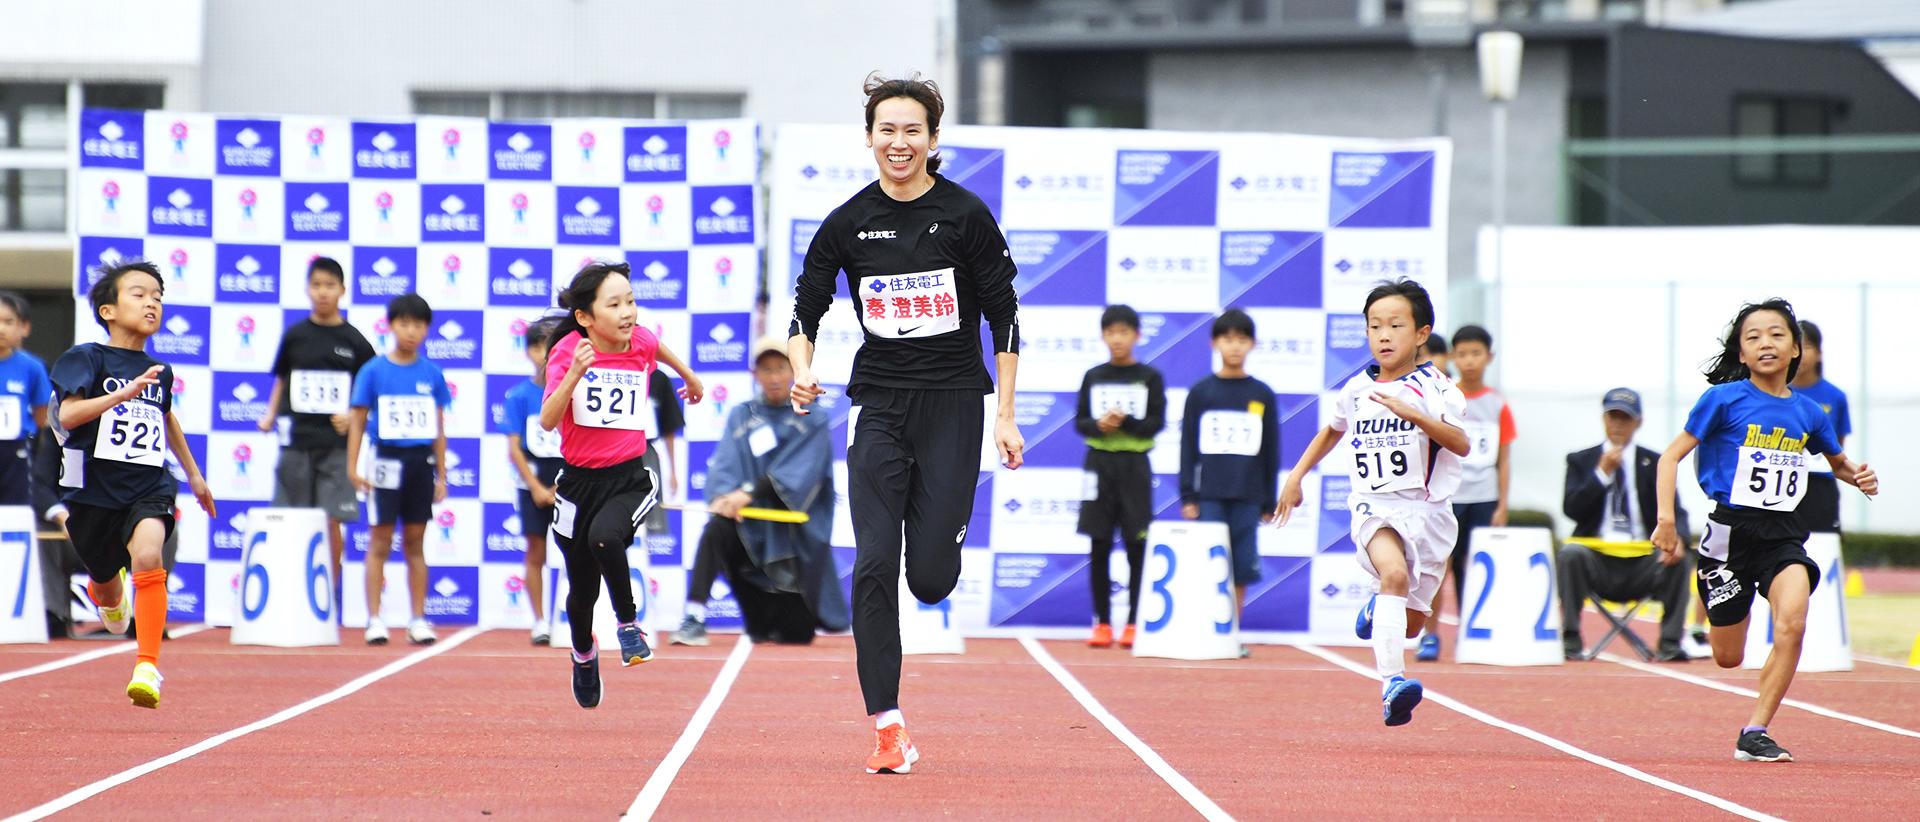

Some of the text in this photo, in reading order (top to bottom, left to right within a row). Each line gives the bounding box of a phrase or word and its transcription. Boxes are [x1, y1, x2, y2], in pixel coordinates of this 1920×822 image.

[889, 273, 945, 292] 住友電工
[865, 291, 955, 320] 秦 澄美鈴
[601, 372, 641, 387] 住友電工
[586, 386, 637, 415] 521
[110, 418, 162, 453] 522
[1365, 435, 1410, 449] 住友電工
[1355, 450, 1409, 479] 519
[1769, 452, 1805, 468] 住友電工
[1748, 466, 1799, 498] 518
[1, 531, 31, 618] 7
[242, 531, 270, 622] 6
[305, 531, 331, 622] 6
[1144, 543, 1178, 633] 3
[1208, 544, 1235, 634] 3
[1465, 550, 1496, 640] 2
[1528, 551, 1558, 641] 2
